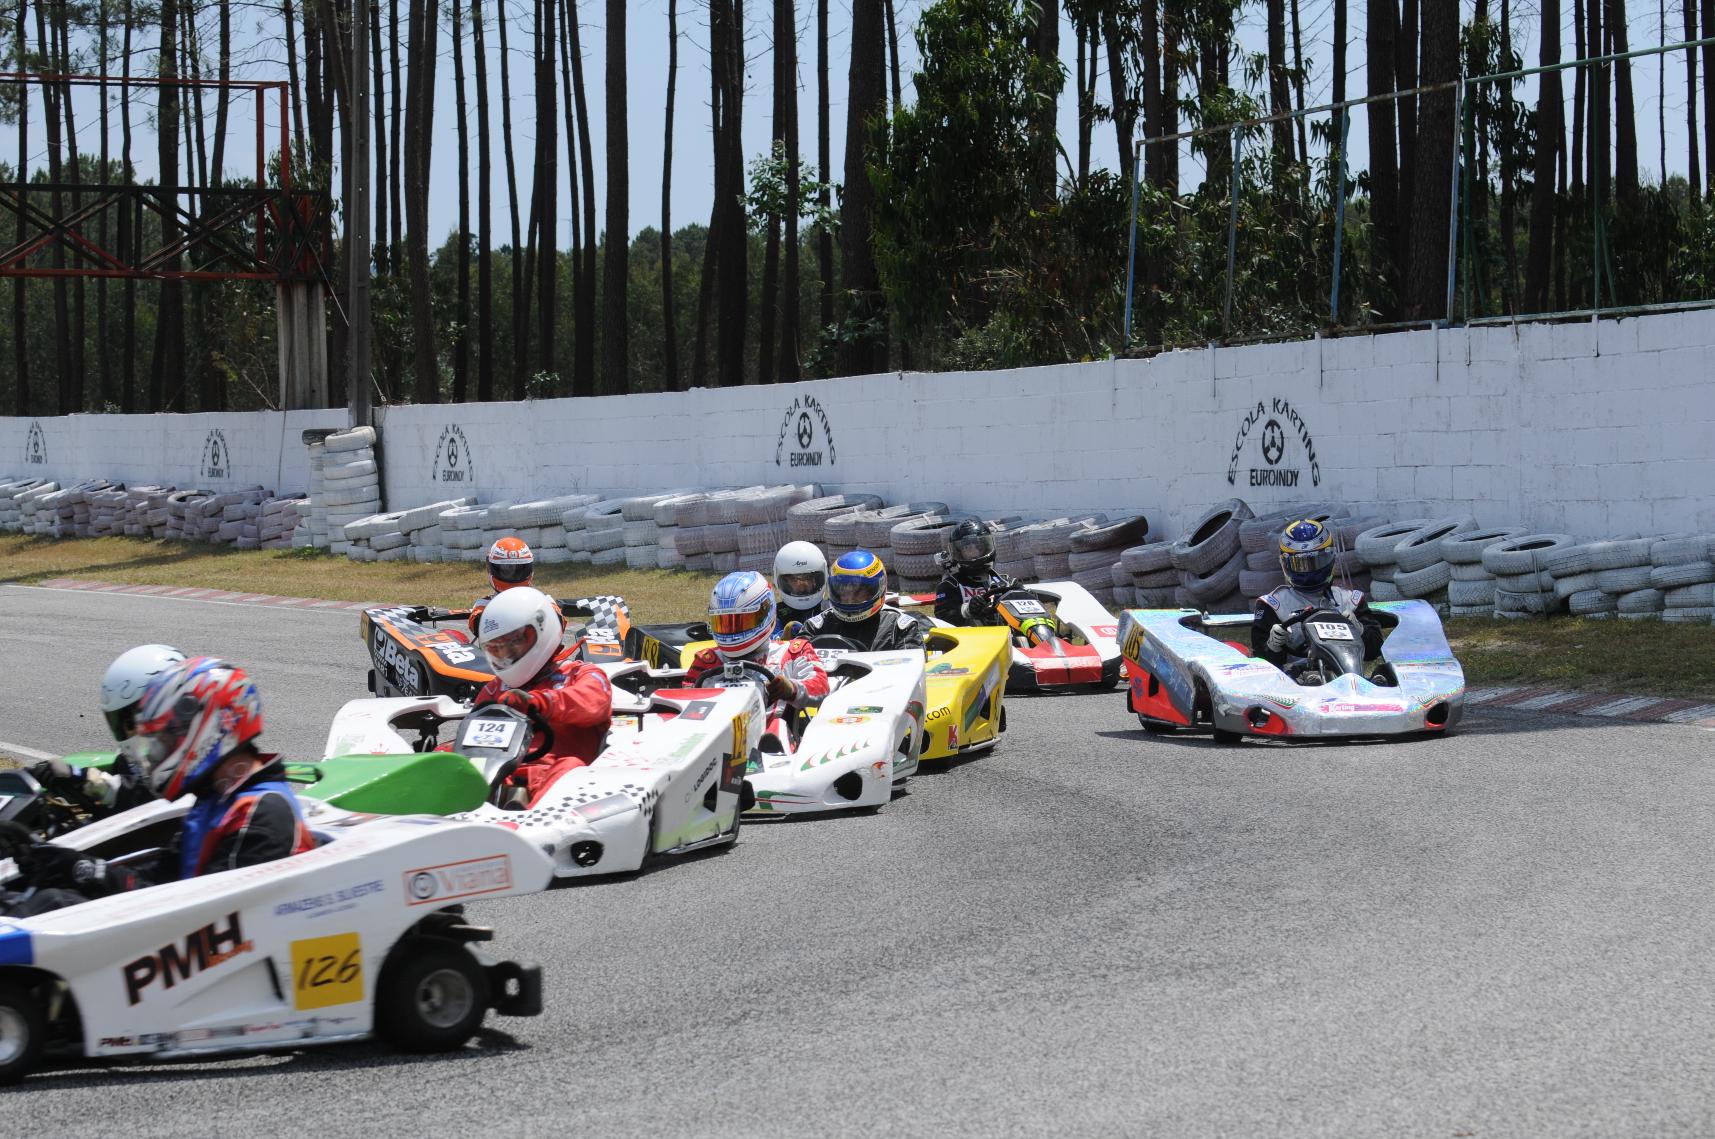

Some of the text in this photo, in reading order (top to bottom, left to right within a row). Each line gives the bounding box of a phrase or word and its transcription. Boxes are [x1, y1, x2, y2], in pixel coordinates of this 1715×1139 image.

[776, 394, 836, 466] ESCOLA KARTING
[1228, 398, 1320, 487] ESCOLA KARTING
[790, 452, 822, 467] EUROINDY
[1249, 469, 1299, 487] EUROINDY
[1318, 623, 1348, 631] 105
[385, 638, 420, 690] Beta
[478, 722, 506, 733] 124
[122, 911, 243, 1007] PMH
[298, 948, 364, 990] 126
